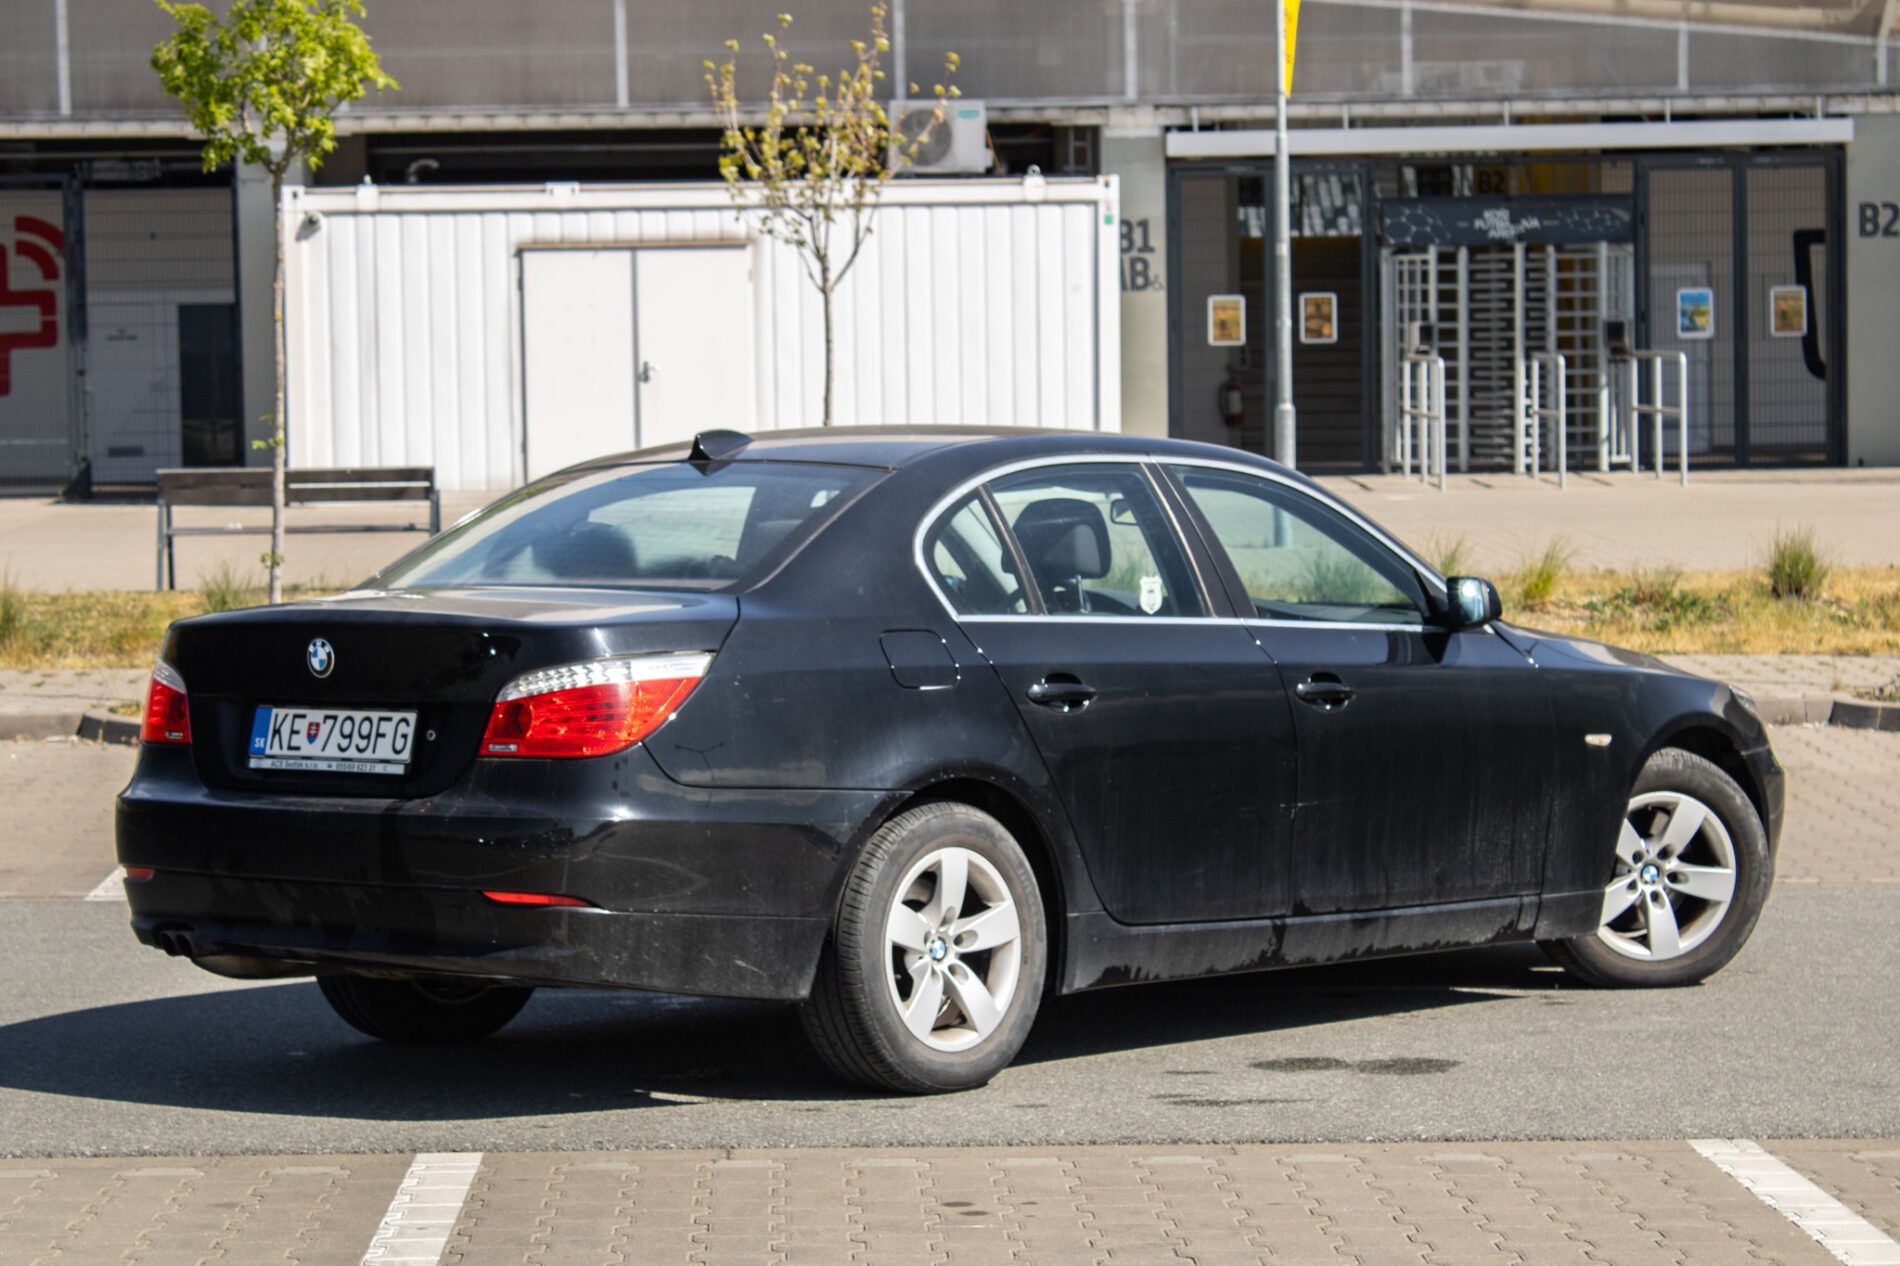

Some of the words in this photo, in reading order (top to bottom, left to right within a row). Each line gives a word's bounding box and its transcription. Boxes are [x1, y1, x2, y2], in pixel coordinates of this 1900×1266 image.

[1859, 202, 1899, 238] B2
[269, 713, 307, 751] KE
[321, 714, 411, 755] 799FG
